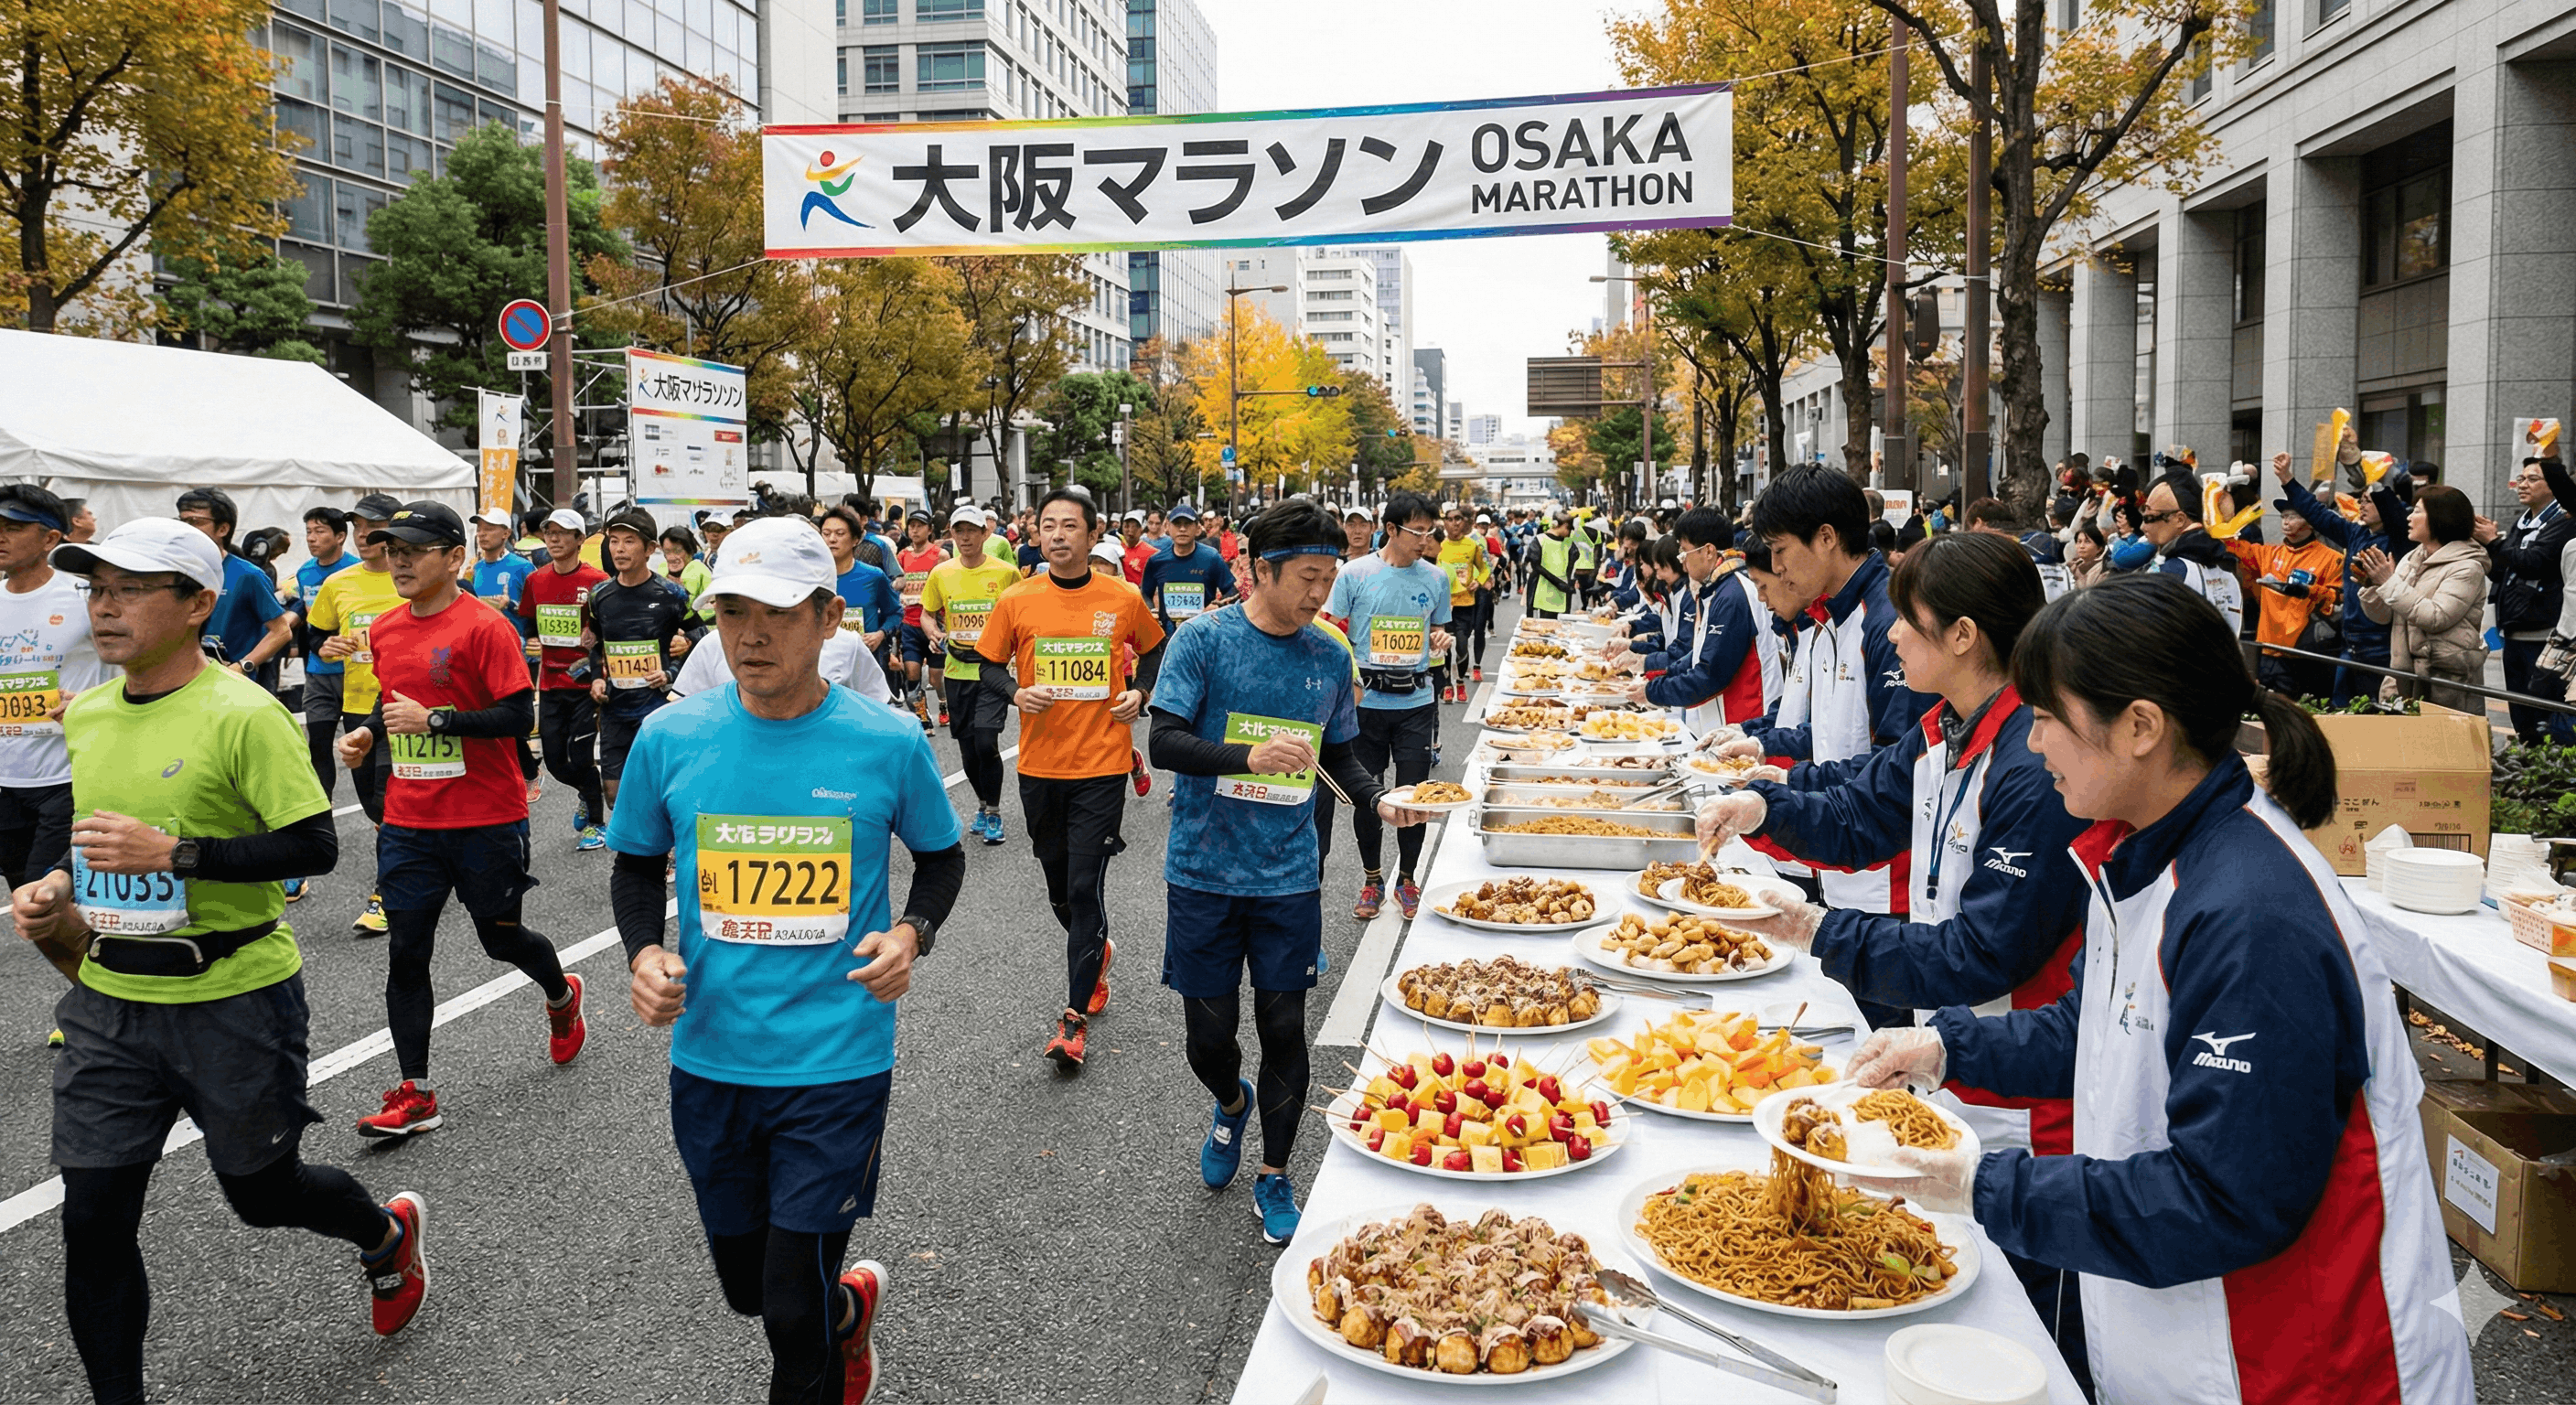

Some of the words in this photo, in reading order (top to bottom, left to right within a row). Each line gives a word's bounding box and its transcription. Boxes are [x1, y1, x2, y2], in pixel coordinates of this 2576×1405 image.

[1471, 112, 1693, 174] OSAKA
[893, 135, 1444, 234] 大阪マラソン
[1471, 171, 1693, 214] MARATHON
[1382, 633, 1421, 650] 16022
[727, 859, 841, 906] 17222
